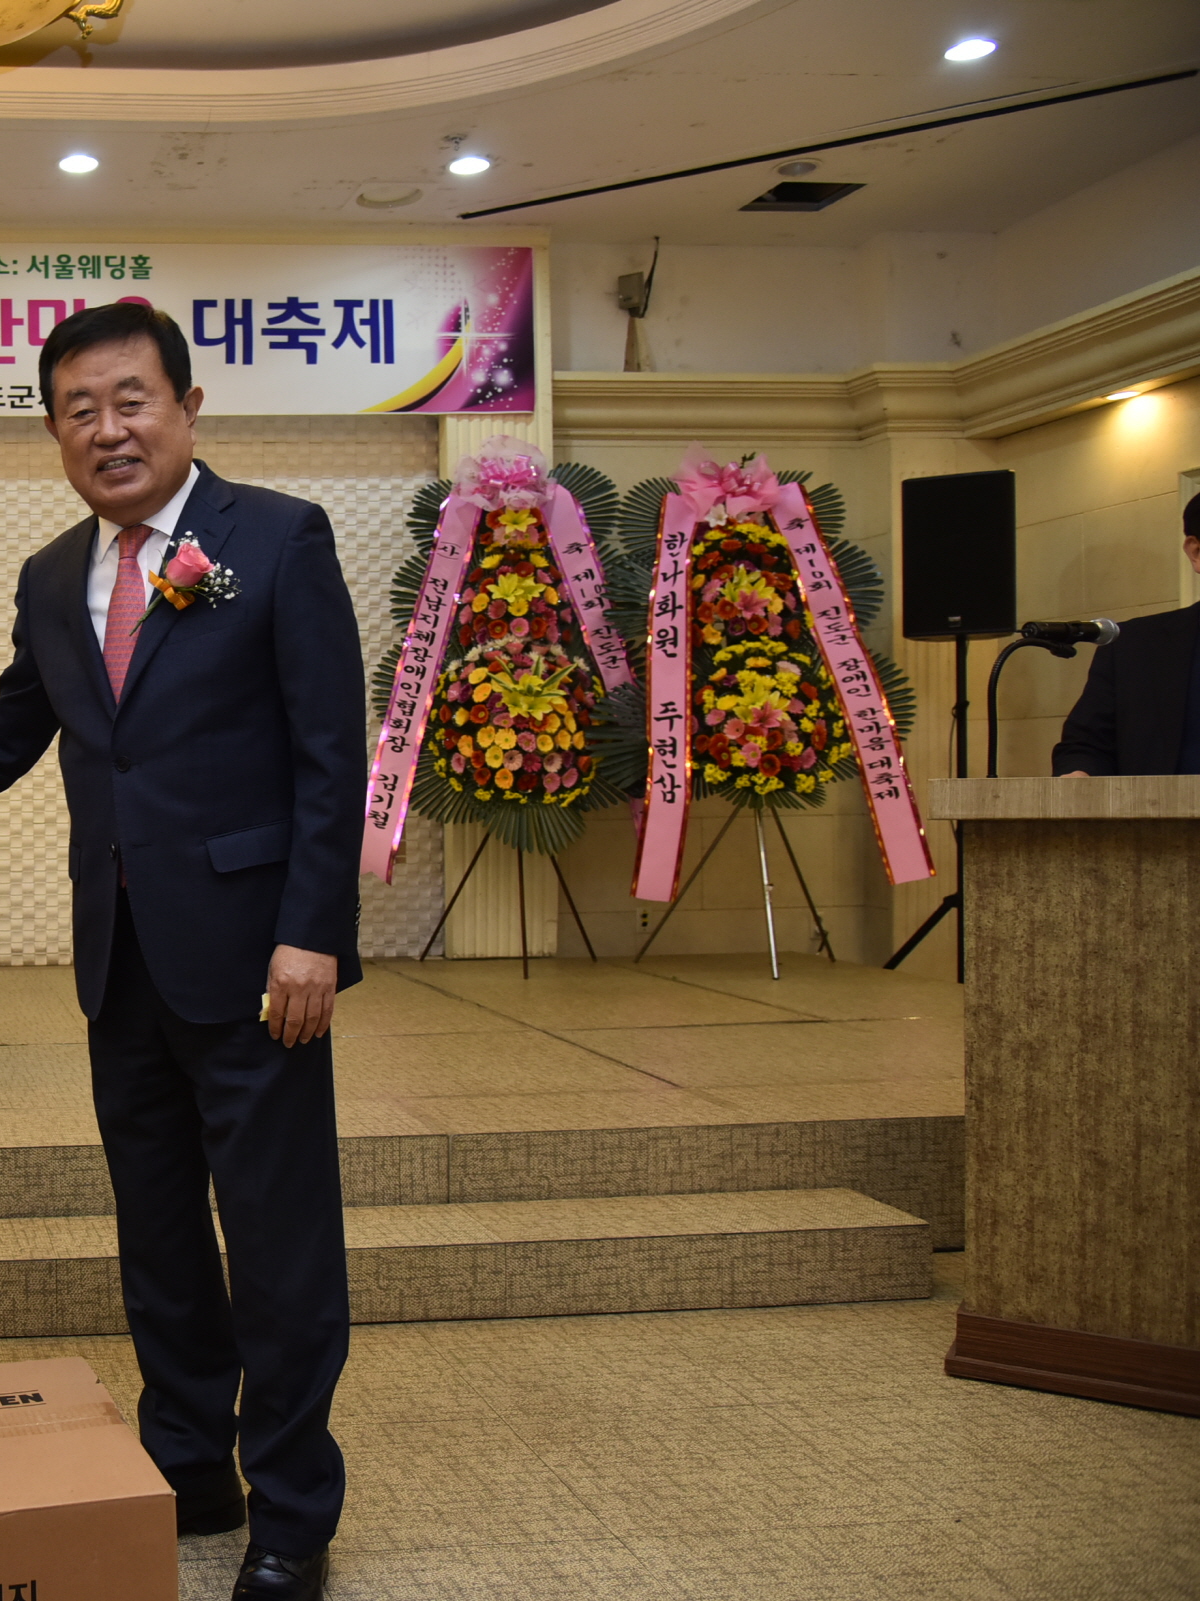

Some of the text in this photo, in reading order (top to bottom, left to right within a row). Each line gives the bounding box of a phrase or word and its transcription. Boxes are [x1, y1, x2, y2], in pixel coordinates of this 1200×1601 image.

[26, 254, 153, 280] 서울웨딩홀
[192, 297, 396, 365] 대축제
[590, 624, 627, 670] 진도군
[816, 605, 854, 646] 진도군
[837, 657, 872, 698] 장애인
[854, 706, 891, 751] 한마음
[867, 756, 901, 801] 대축제
